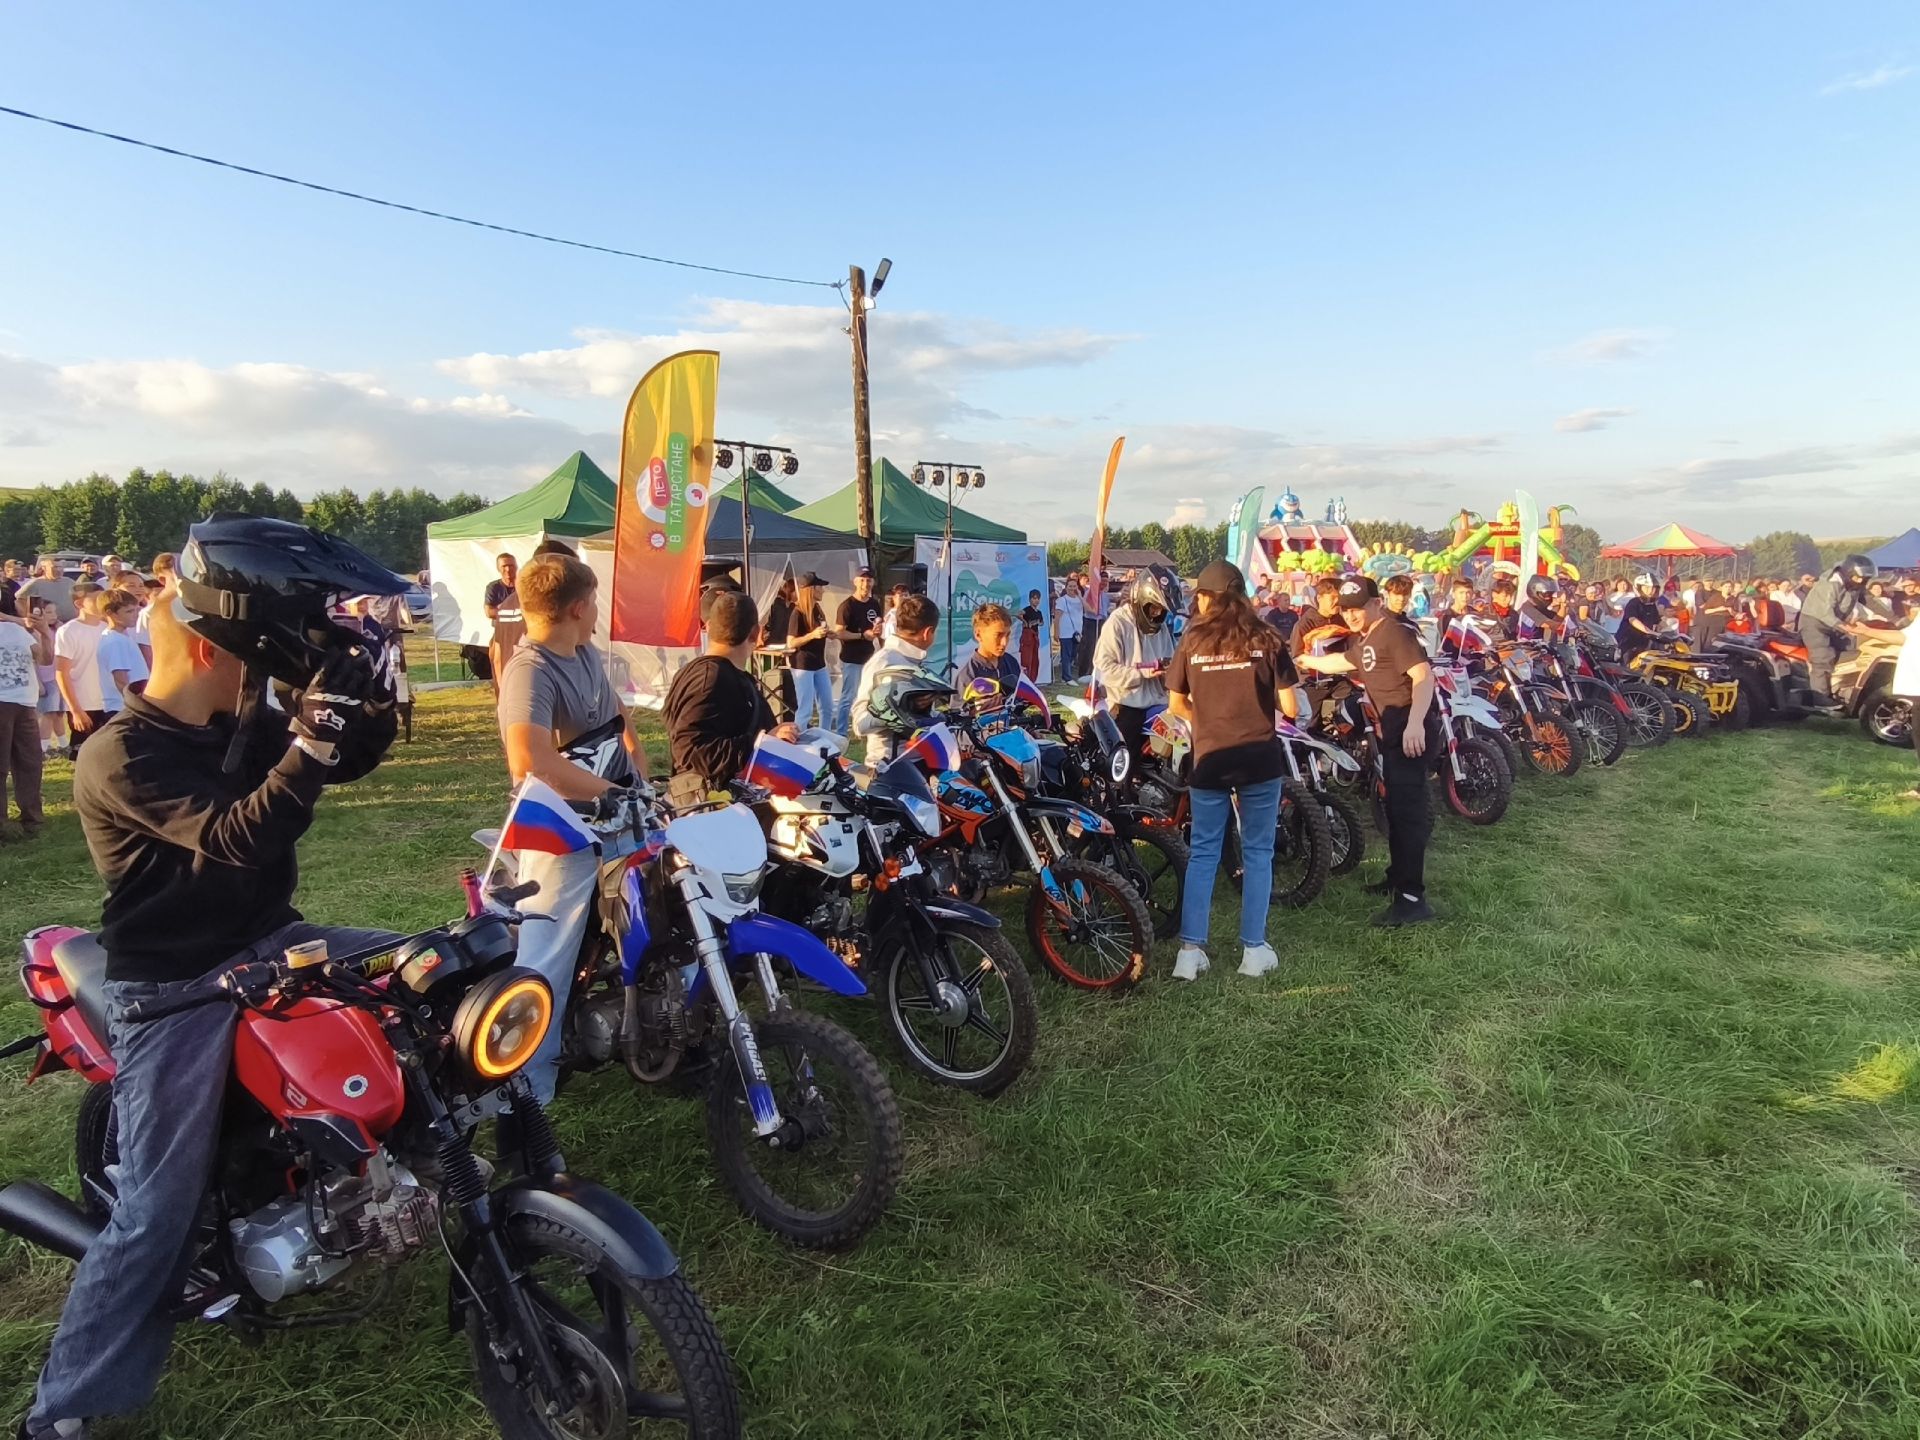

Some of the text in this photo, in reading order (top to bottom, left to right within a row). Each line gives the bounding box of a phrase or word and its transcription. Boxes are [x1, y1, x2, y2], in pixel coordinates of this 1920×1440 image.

[653, 464, 667, 498] ЛЕТО
[669, 442, 683, 543] В ТАТАРСТАНЕ
